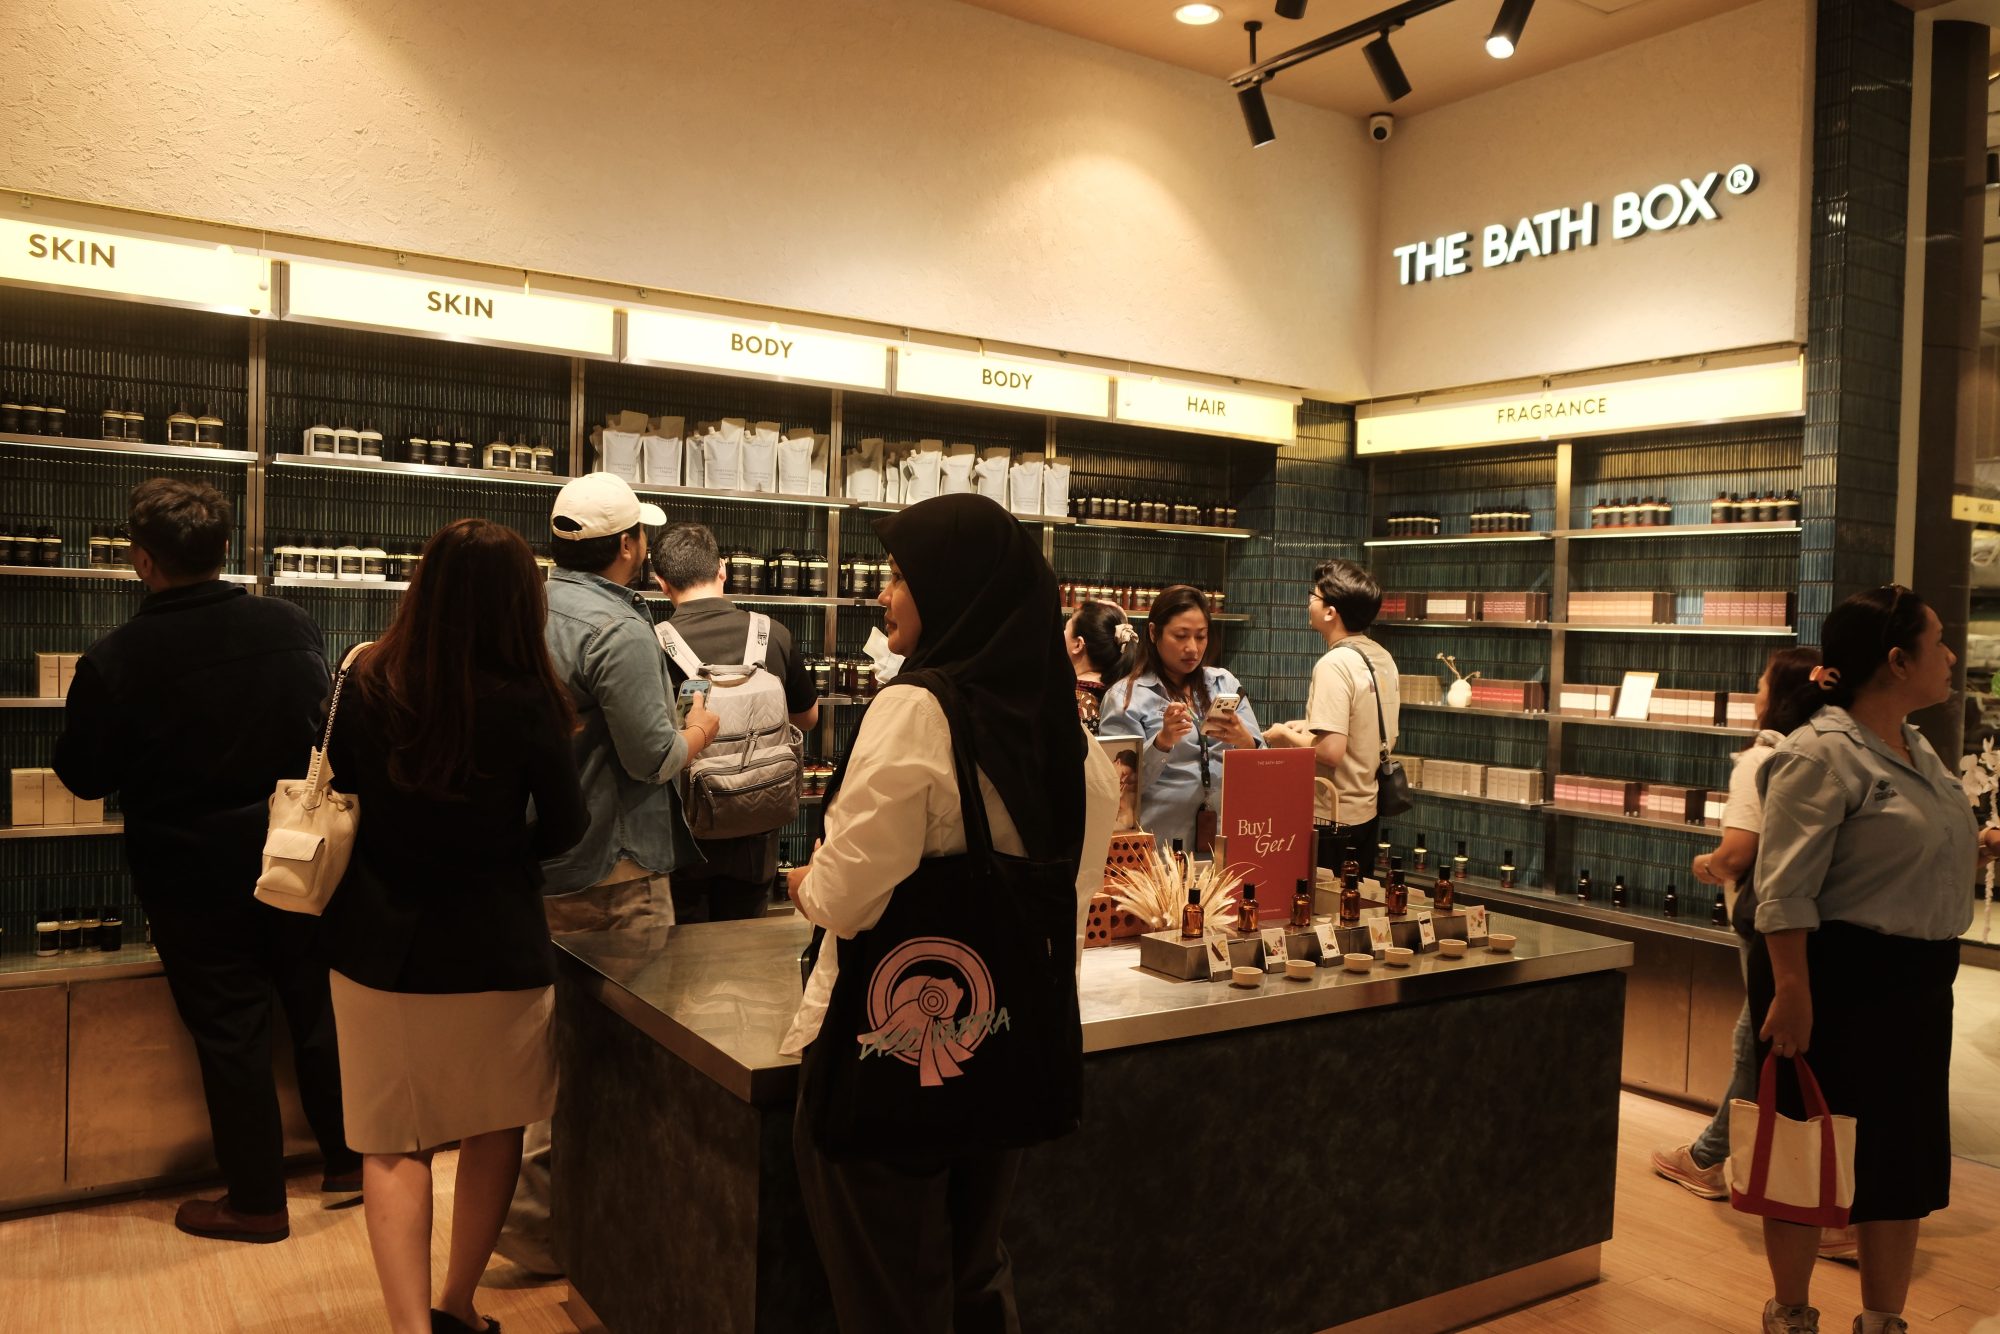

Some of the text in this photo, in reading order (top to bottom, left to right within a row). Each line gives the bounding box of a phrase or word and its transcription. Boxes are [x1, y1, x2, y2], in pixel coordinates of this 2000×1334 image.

[28, 233, 115, 268] SKIN
[1393, 231, 1469, 286] THE
[1482, 201, 1596, 268] BATH
[427, 291, 493, 319] SKIN
[731, 333, 793, 358] BODY
[982, 368, 1032, 389] BODY
[1187, 396, 1226, 415] HAIR
[1498, 398, 1606, 424] FRAGRANCE
[1237, 817, 1273, 839] Buy 1
[1255, 834, 1285, 858] Get
